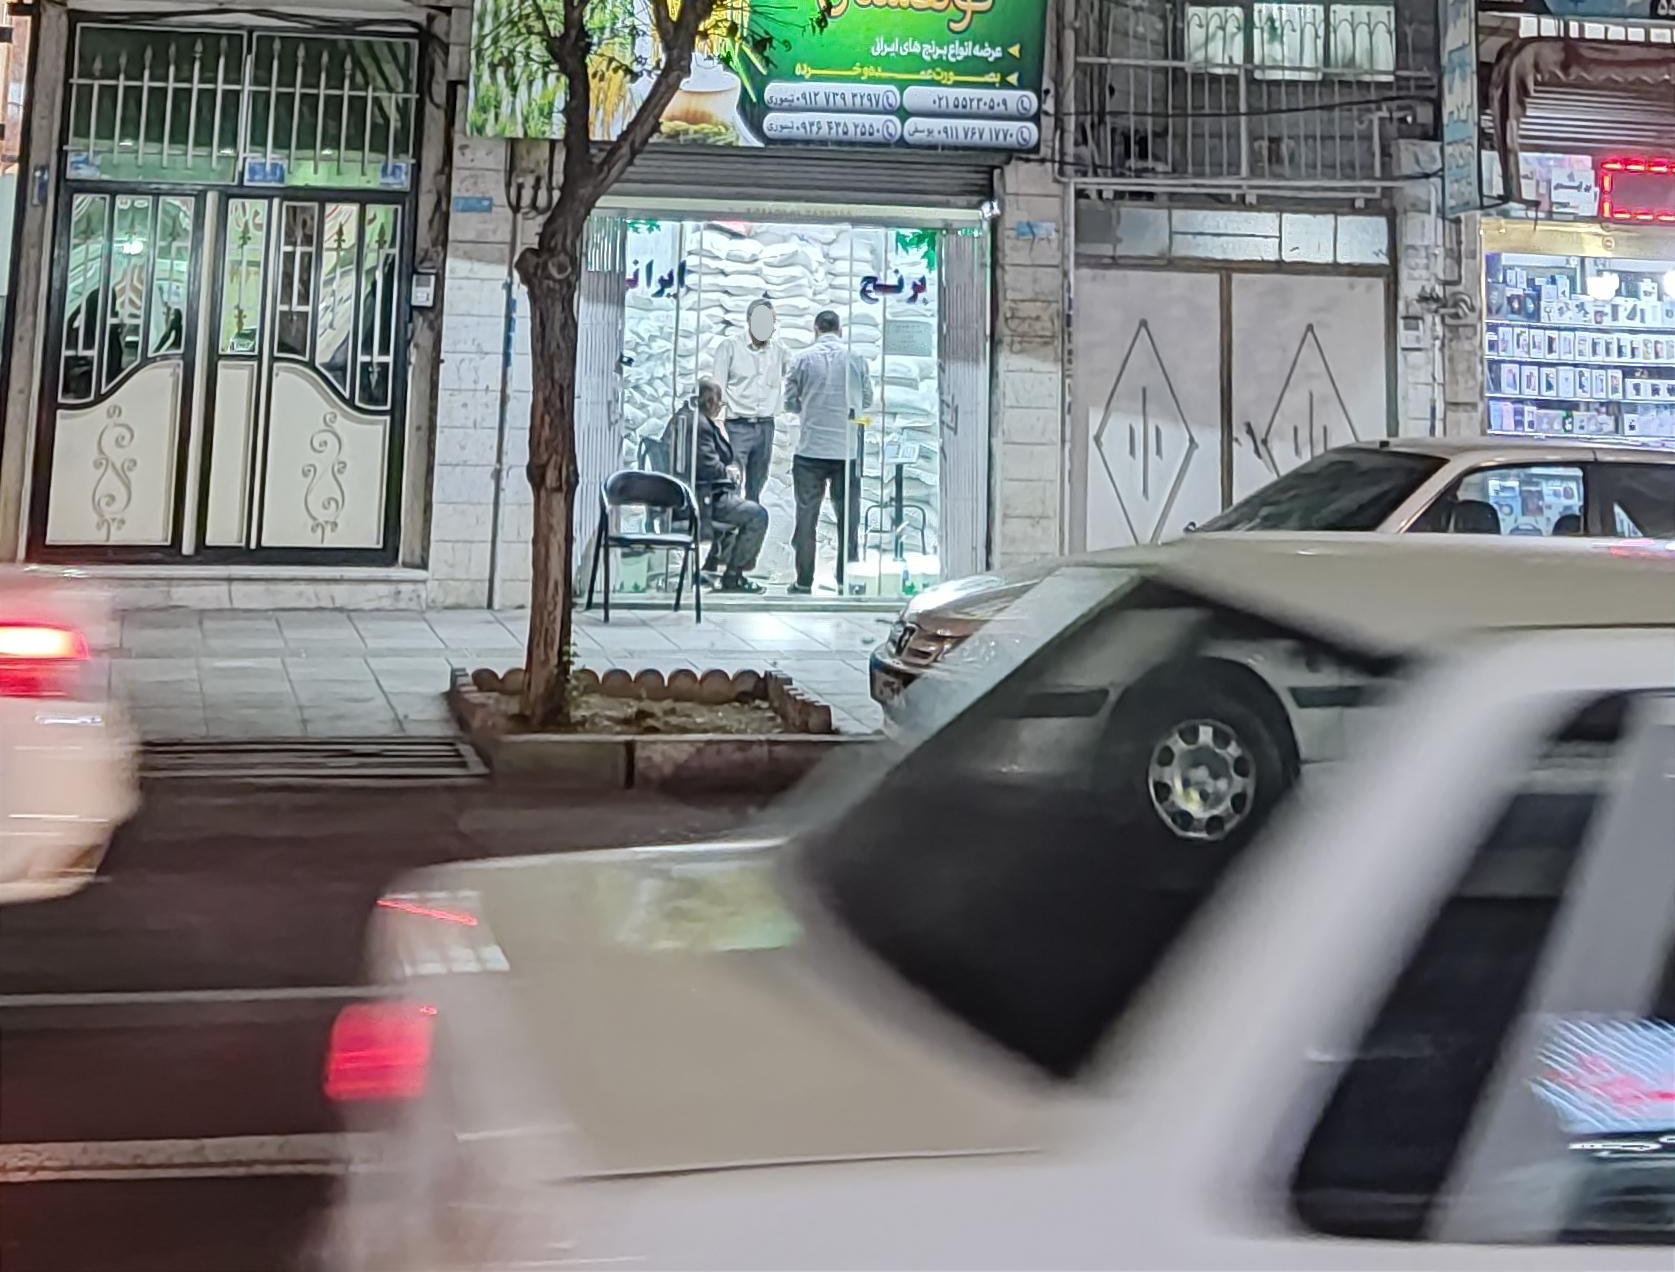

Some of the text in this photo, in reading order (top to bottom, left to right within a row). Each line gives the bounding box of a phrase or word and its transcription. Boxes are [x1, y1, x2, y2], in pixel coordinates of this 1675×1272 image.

[871, 37, 899, 57] ایرانی
[899, 38, 921, 56] های
[948, 40, 973, 62] انواع
[972, 42, 1003, 62] عرضه
[932, 94, 949, 109] ۰۲۱
[937, 125, 959, 141] ۰۹۱۱
[989, 127, 1013, 142] ۱۷۷۰
[625, 259, 927, 306] برنج ایران
